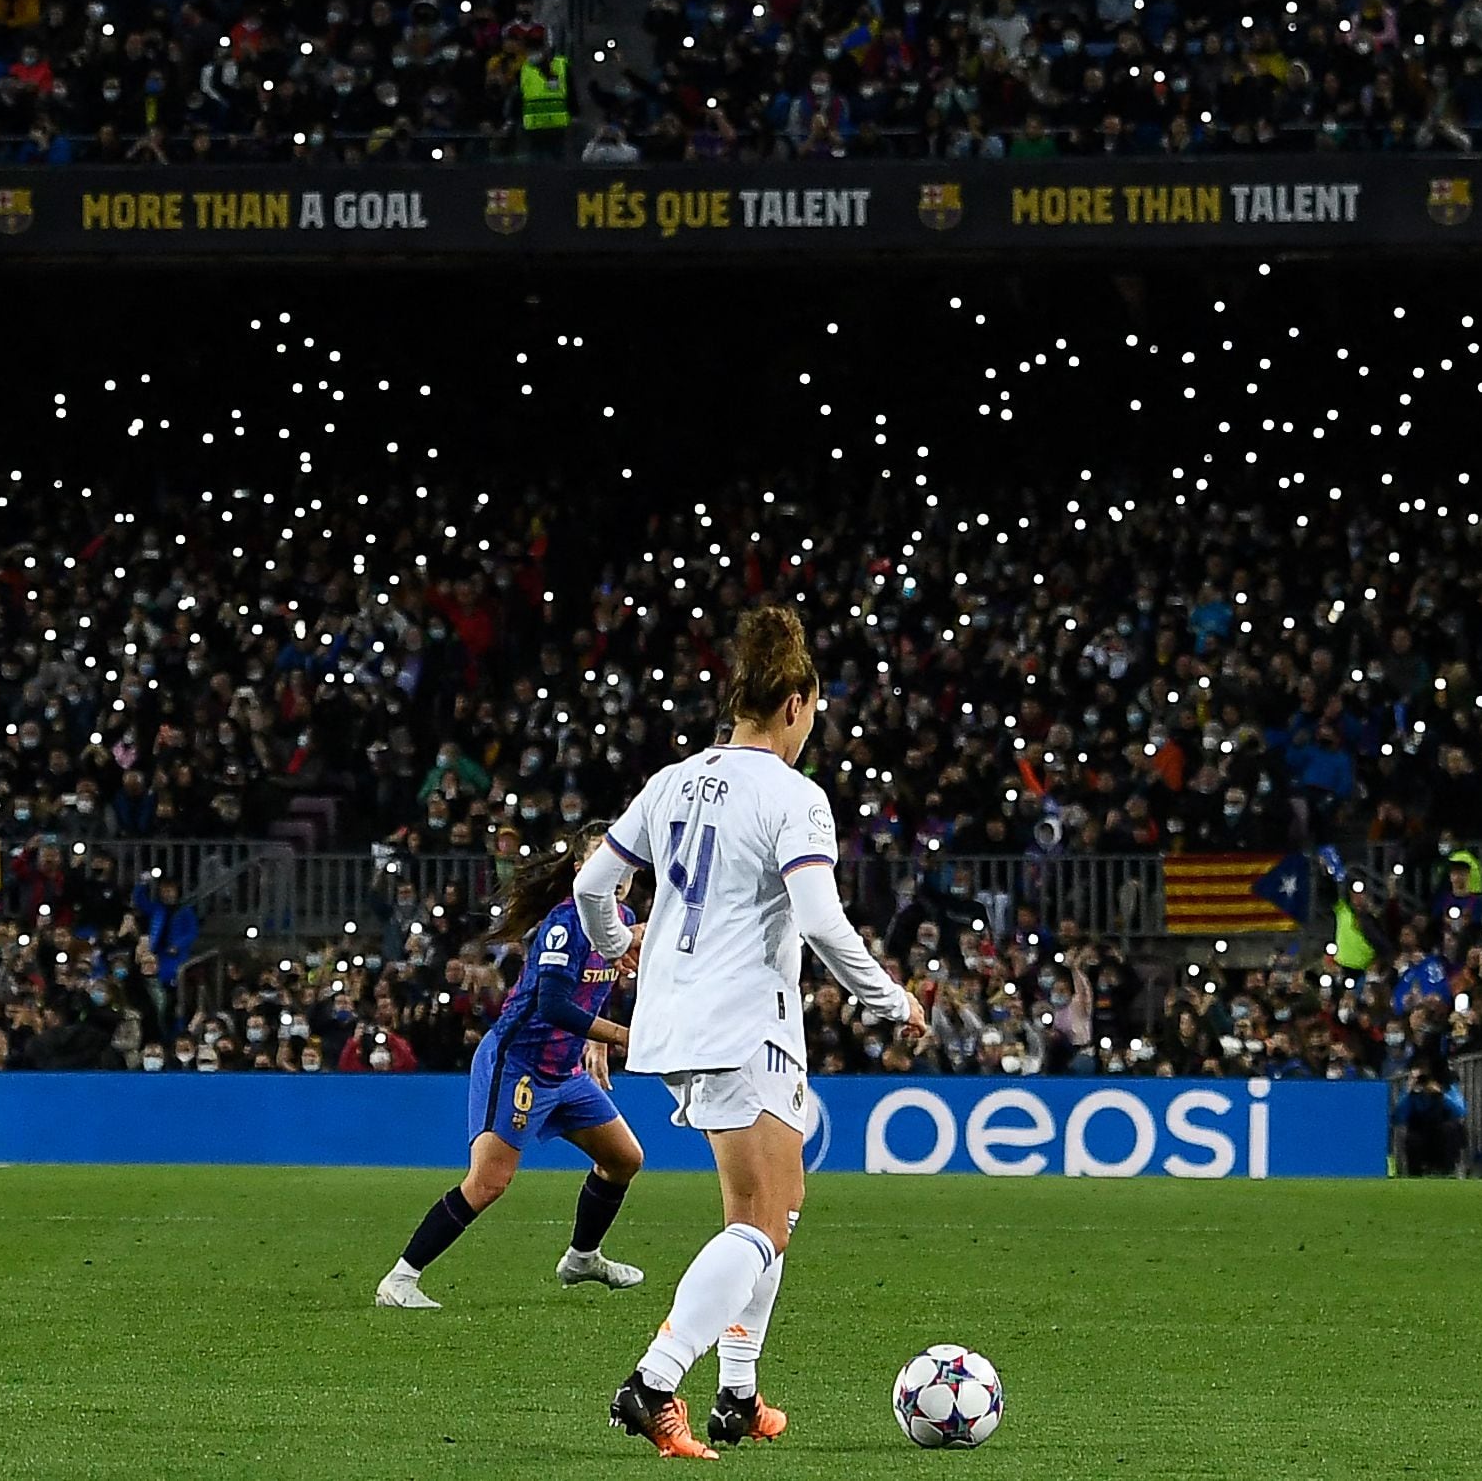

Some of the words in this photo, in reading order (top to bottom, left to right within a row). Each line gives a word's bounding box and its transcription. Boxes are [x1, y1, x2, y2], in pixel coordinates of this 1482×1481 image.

[82, 192, 183, 228] MORE
[194, 192, 290, 228] THAN
[299, 192, 324, 228] A
[333, 192, 427, 228] GOAL
[577, 182, 649, 228] MÉS
[657, 190, 730, 235] QUE
[741, 189, 870, 226] TALENT
[1012, 187, 1116, 225] MORE
[1123, 187, 1220, 225] THAN
[1230, 186, 1360, 222] TALENT
[668, 820, 718, 954] 4
[512, 1074, 534, 1112] 6
